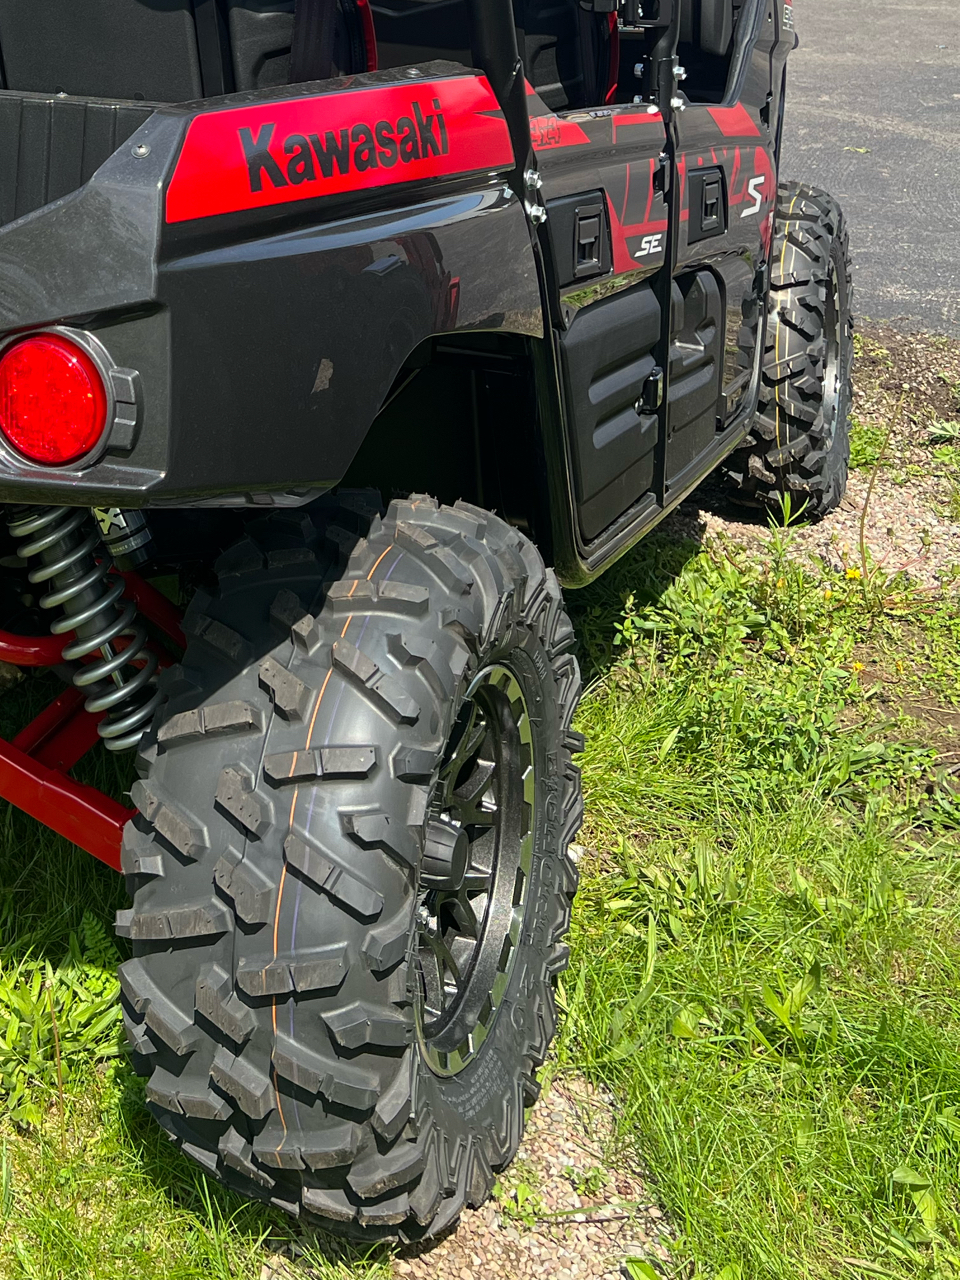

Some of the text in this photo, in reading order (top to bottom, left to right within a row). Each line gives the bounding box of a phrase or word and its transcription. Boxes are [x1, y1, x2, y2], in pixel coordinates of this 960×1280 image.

[238, 98, 449, 192] Kawasaki
[740, 175, 765, 218] S
[634, 233, 663, 258] SE
